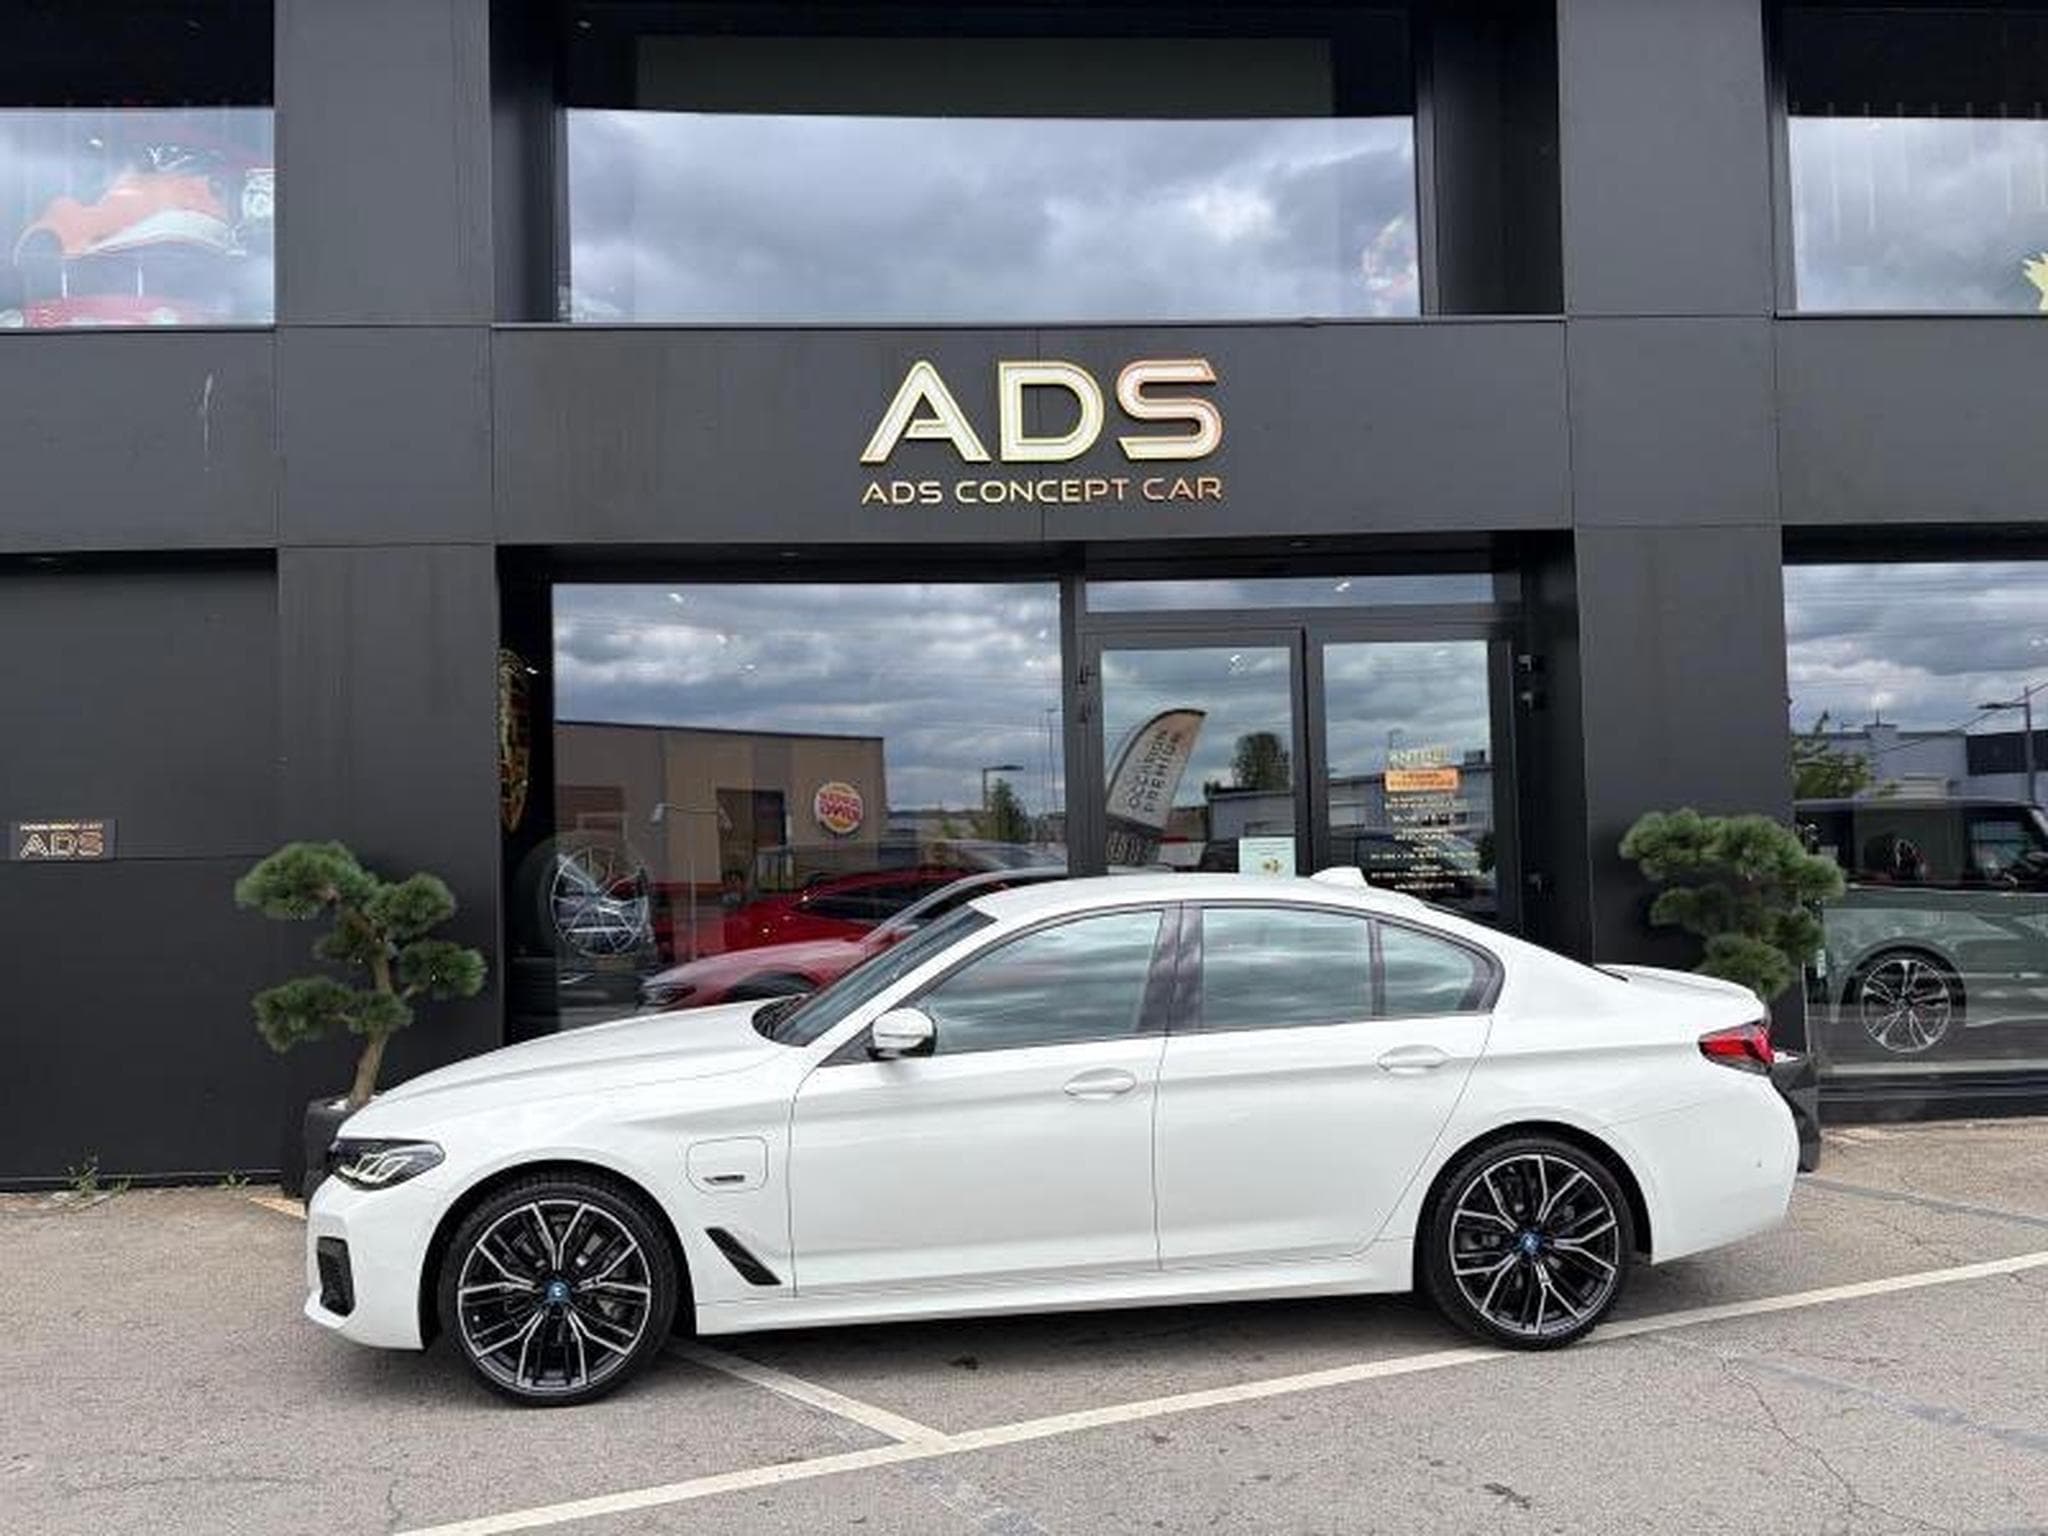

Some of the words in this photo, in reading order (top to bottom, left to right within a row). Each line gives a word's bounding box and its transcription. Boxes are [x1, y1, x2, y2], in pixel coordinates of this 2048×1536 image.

[860, 359, 1222, 463] ADS
[861, 481, 942, 504] ADS
[956, 478, 1129, 504] CONCEPT
[1143, 477, 1222, 501] CAR
[20, 832, 104, 858] ADS
